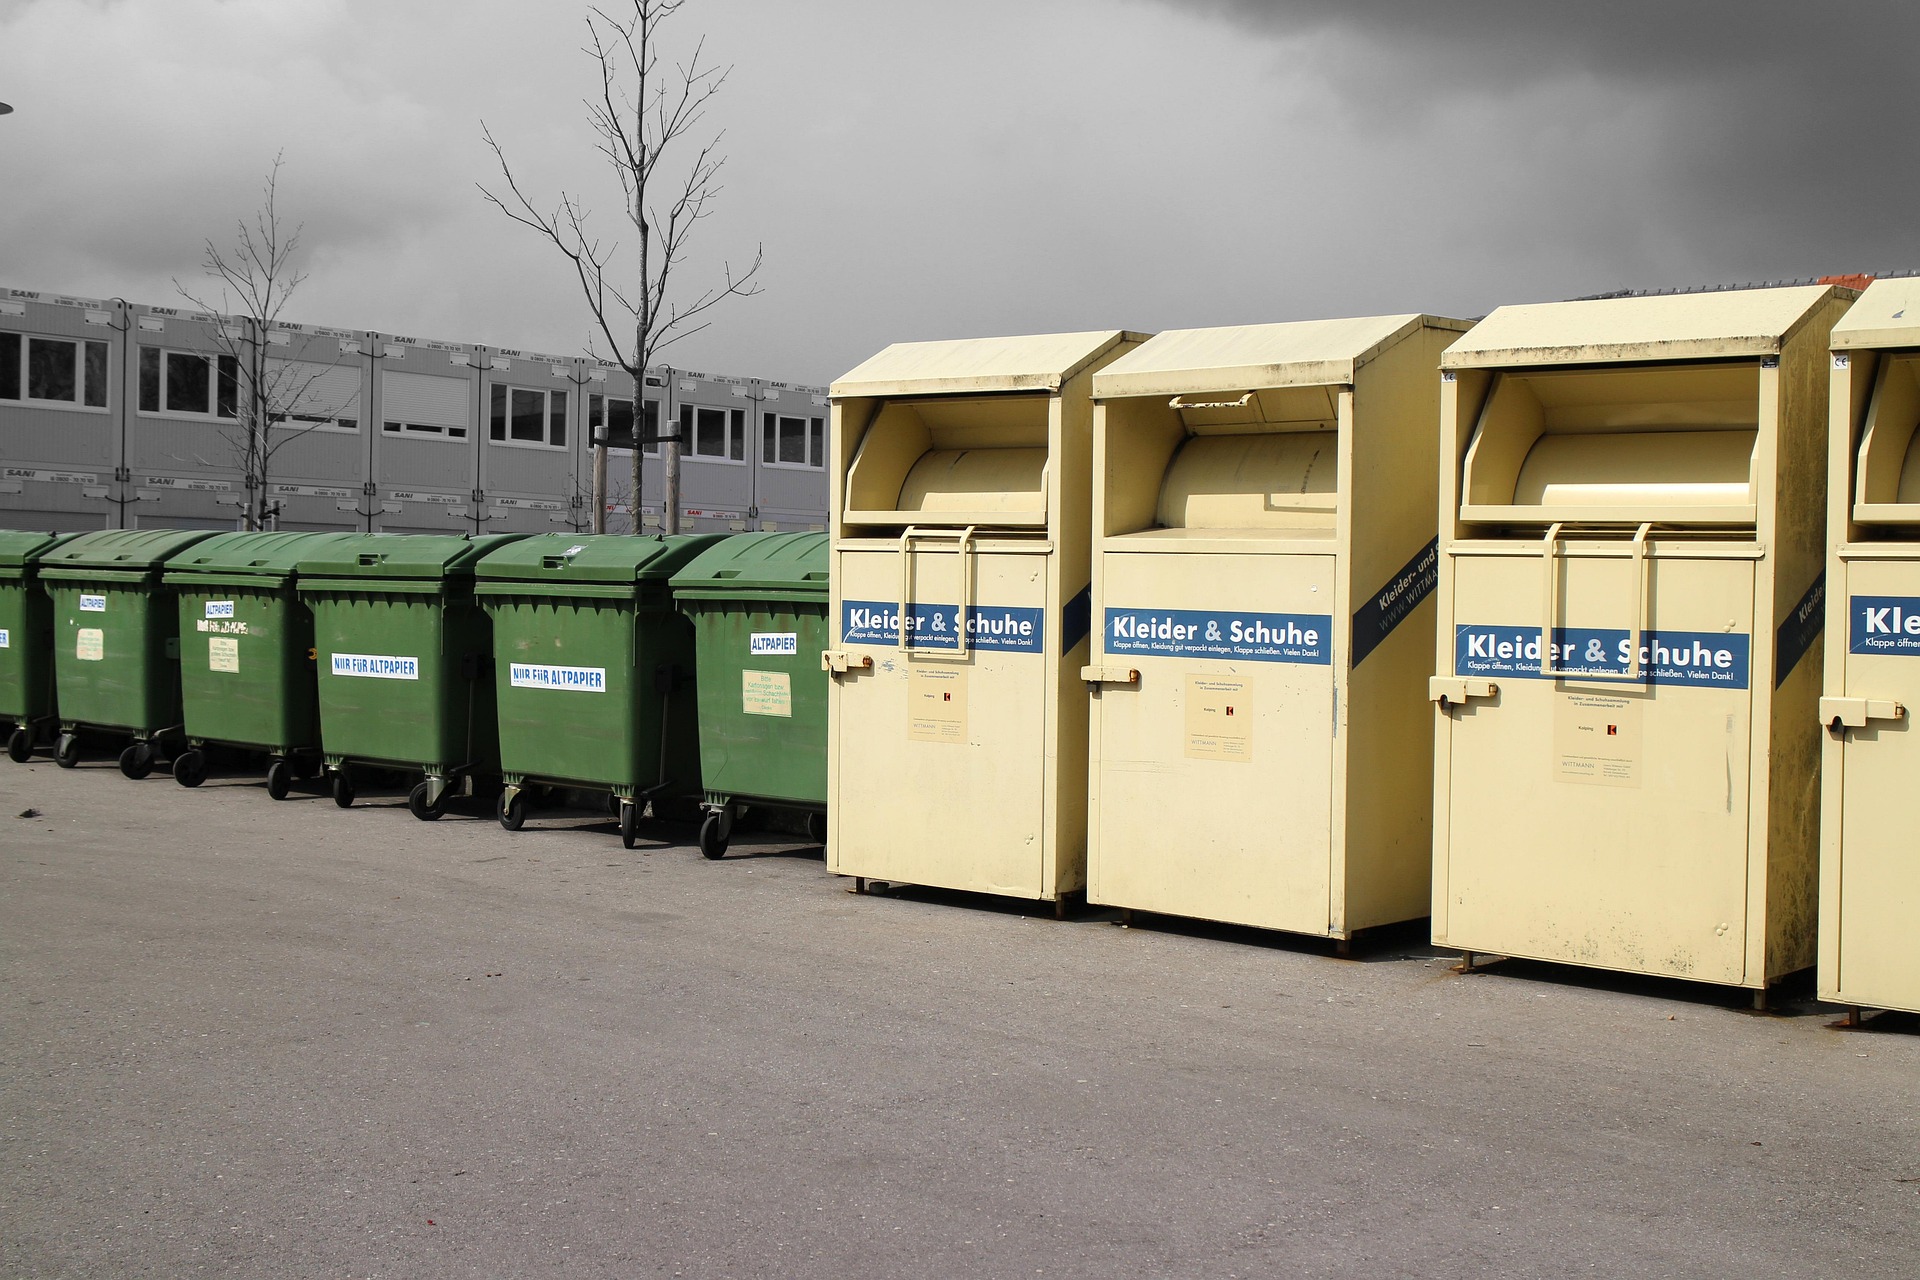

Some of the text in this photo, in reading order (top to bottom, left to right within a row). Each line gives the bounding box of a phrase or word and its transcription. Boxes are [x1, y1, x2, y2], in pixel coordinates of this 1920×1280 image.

[10, 289, 40, 299] SANI
[151, 307, 178, 316] SANI
[278, 322, 303, 331] SANI
[394, 336, 417, 344] SANI
[500, 348, 521, 357] SANI
[687, 371, 706, 379] SANI
[770, 381, 788, 389] SANI
[6, 469, 36, 478] SANI
[148, 477, 175, 486] SANI
[1379, 547, 1436, 611] Kleider- und
[207, 604, 233, 615] ALTPAPIER
[850, 607, 925, 631] Kleider
[931, 612, 947, 632] &
[1113, 616, 1319, 646] Kleider & Schuhe
[752, 637, 795, 650] ALTPAPIER
[850, 630, 866, 640] Klappe
[913, 633, 934, 642] verpackt
[1000, 637, 1017, 646] Vielen
[1017, 638, 1033, 646] Dank!
[1865, 637, 1895, 649] Klappe
[1113, 640, 1319, 658] Klappe öffnen, Kleidung gut verpackt einlegen, Klappe schließen. Vielen Dank!
[1468, 634, 1733, 668] Kleider & Schuhe
[352, 658, 368, 673] FÜR
[369, 659, 415, 675] ALTPAPIER
[1467, 660, 1491, 671] Klappe
[1491, 662, 1514, 672] öffnen,
[1649, 668, 1685, 679] schließen.
[1687, 670, 1710, 680] Vielen
[1711, 671, 1734, 681] Dank!
[551, 669, 602, 688] ALTPAPIER
[1562, 761, 1595, 769] WITTMANN
